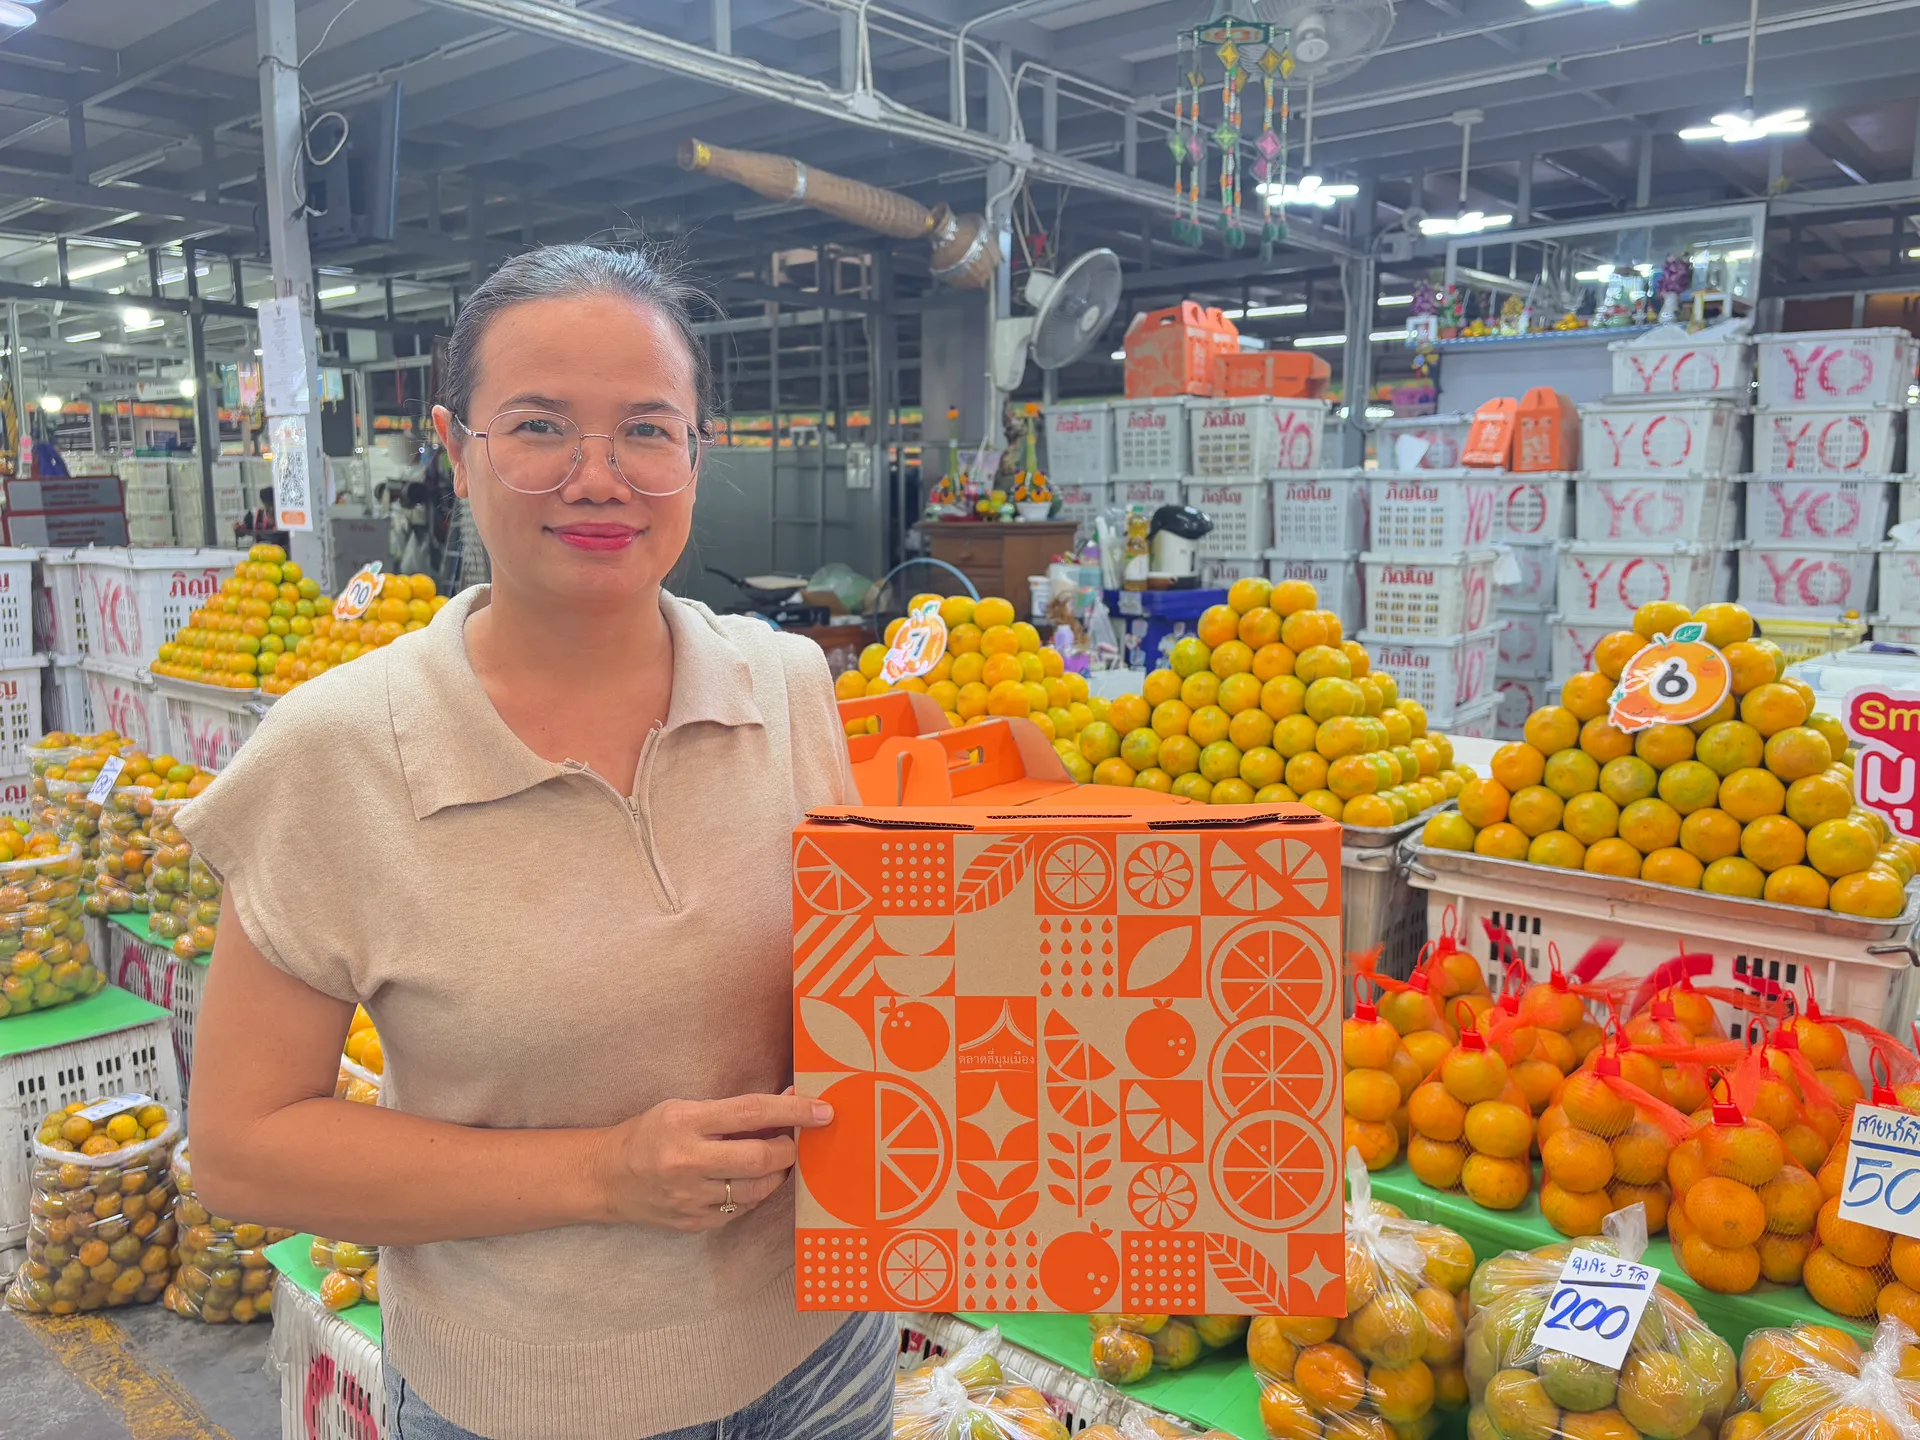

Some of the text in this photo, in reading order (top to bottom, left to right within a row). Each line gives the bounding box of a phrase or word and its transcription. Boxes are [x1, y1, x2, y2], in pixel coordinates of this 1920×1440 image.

[1783, 345, 1874, 400] YO
[1600, 415, 1692, 467] YO
[1774, 418, 1870, 470] YO
[1597, 486, 1684, 538] YO
[1768, 485, 1862, 540] YO
[169, 568, 221, 598] ภิญโ
[1574, 555, 1671, 610] YO
[1760, 553, 1852, 606] YO
[911, 631, 928, 657] 7
[1656, 663, 1689, 698] 6
[958, 1048, 1035, 1069] ตลาดสี่มุมเมือง
[1842, 1156, 1920, 1216] 50
[1543, 1287, 1630, 1340] 200
